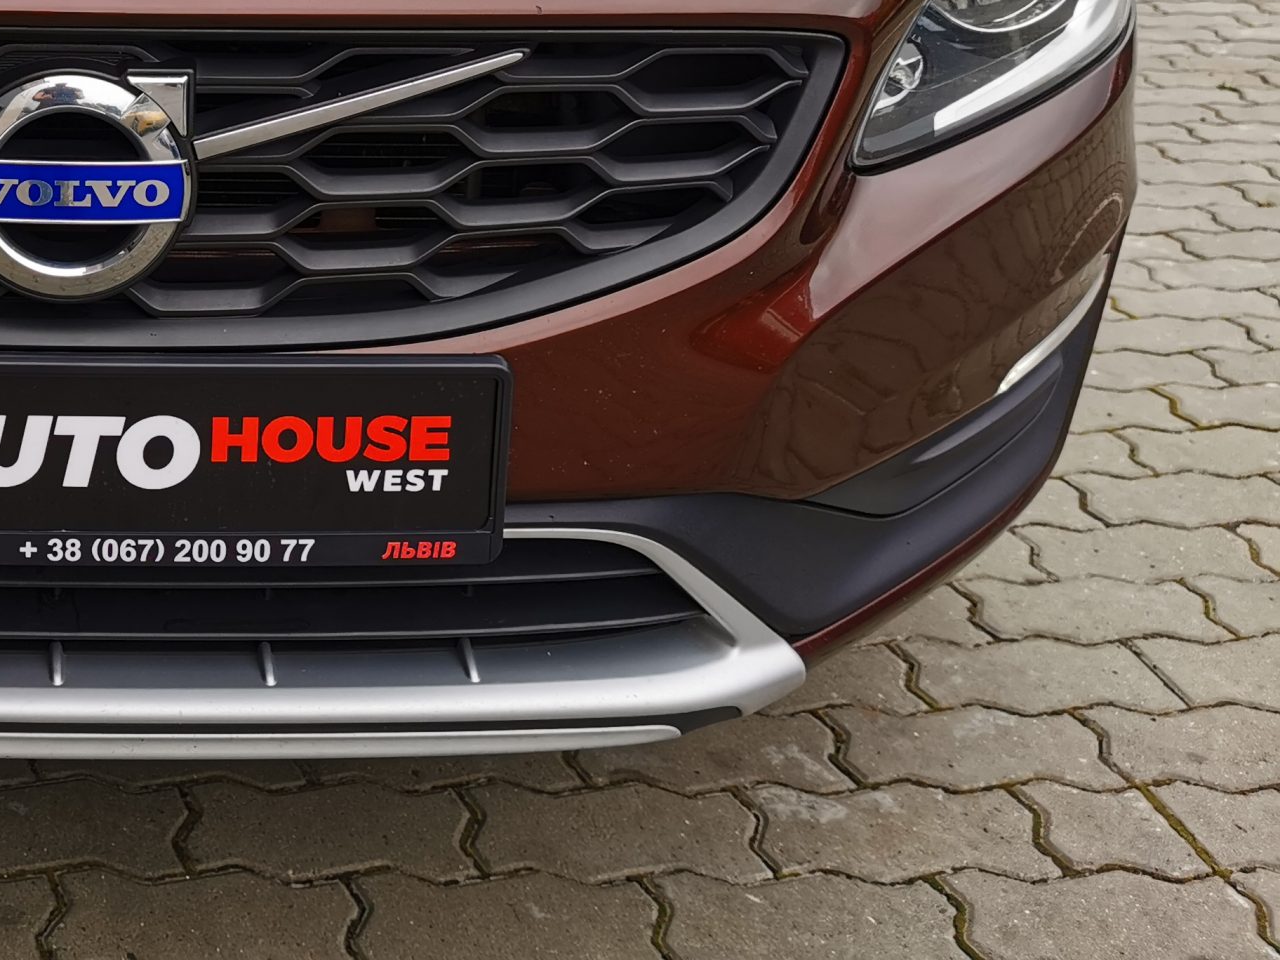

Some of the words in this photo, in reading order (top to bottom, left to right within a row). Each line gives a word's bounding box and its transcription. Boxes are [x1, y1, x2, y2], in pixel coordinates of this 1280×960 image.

[211, 415, 452, 463] HOUSE
[346, 469, 449, 492] WEST
[47, 538, 82, 561] 38
[91, 538, 165, 562] (067)
[174, 539, 227, 562] 200
[236, 539, 271, 561] 90
[280, 539, 315, 561] 77
[381, 541, 456, 559] ЛЬВІВ
